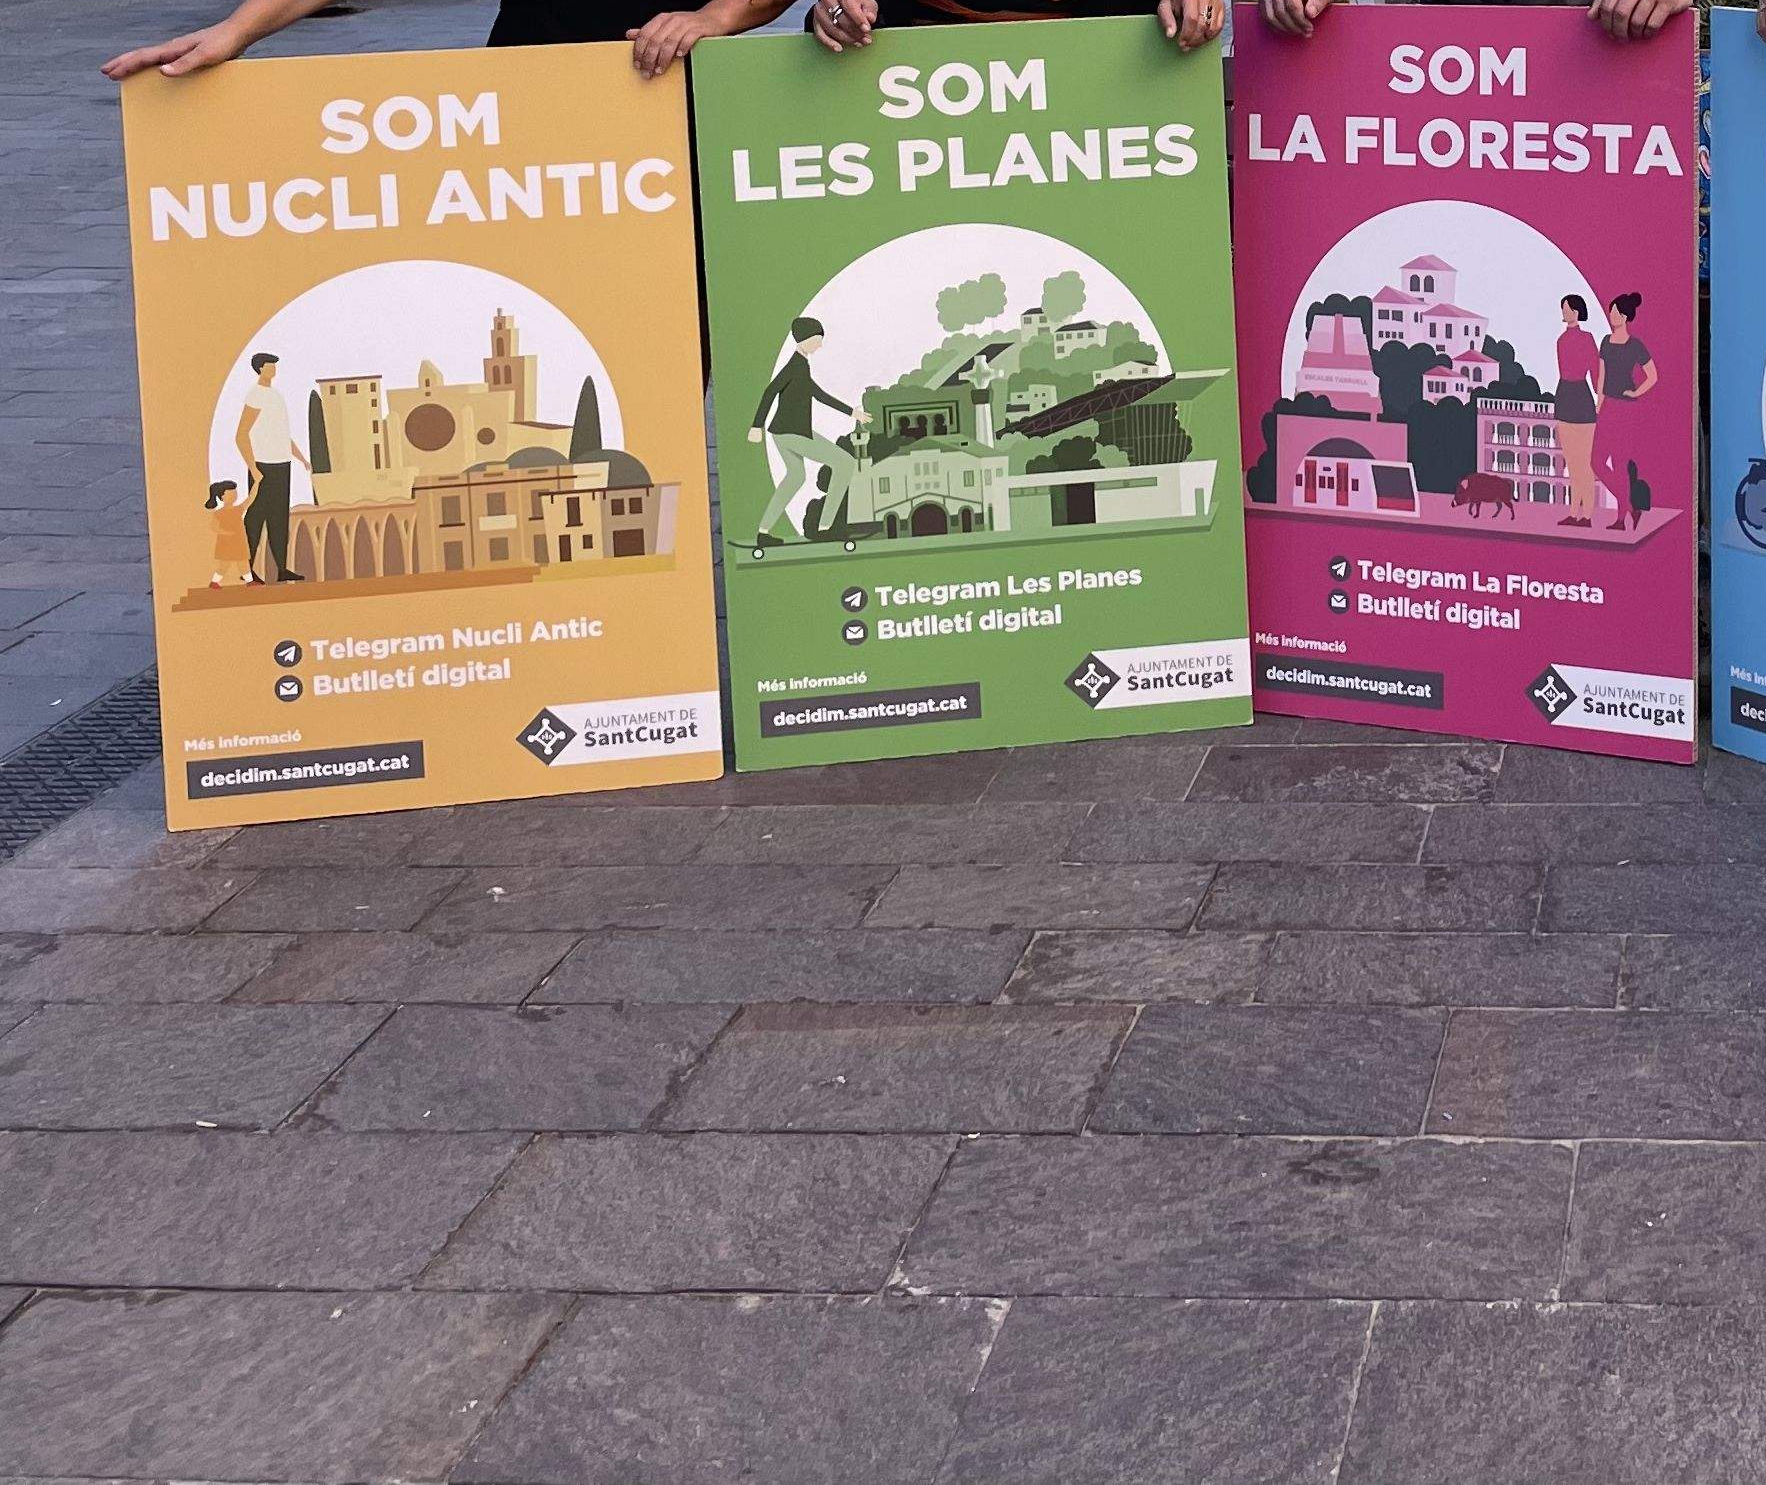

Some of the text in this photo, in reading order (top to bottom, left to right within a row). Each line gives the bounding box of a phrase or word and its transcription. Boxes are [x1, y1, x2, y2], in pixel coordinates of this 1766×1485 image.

[1387, 44, 1527, 97] SOM
[878, 58, 1047, 119] SOM
[321, 92, 501, 154] SOM
[732, 123, 1198, 202] LES PLANES
[1248, 113, 1684, 177] LA FLORESTA
[149, 158, 677, 241] NUCLI ANTIC
[875, 566, 1143, 610] Telegram Les Planes
[1357, 559, 1605, 605] Telegram La Floresta
[876, 604, 1062, 641] Butlletí digital
[1357, 593, 1521, 630] Butlletí digital
[310, 616, 604, 662] Telegram Nucli Antic
[1255, 631, 1347, 654] Més informació
[312, 658, 511, 696] Butlletí digital
[757, 670, 867, 693] Més informació
[1126, 653, 1233, 675] AJUNTAMENT DE
[1126, 667, 1234, 694] SantCugat
[1730, 665, 1752, 683] Més
[1266, 666, 1432, 698] decidim.santcugat.cat
[1583, 683, 1685, 706] AJUNTAMENT DE
[584, 707, 698, 730] AJUNTAMENT DE
[772, 694, 968, 727] decidim.santcugat.cat
[1582, 695, 1686, 726] SantCugat
[183, 728, 302, 752] Més informació
[584, 722, 698, 748] SantCugat
[200, 753, 411, 788] decidim.santcugat.cat
